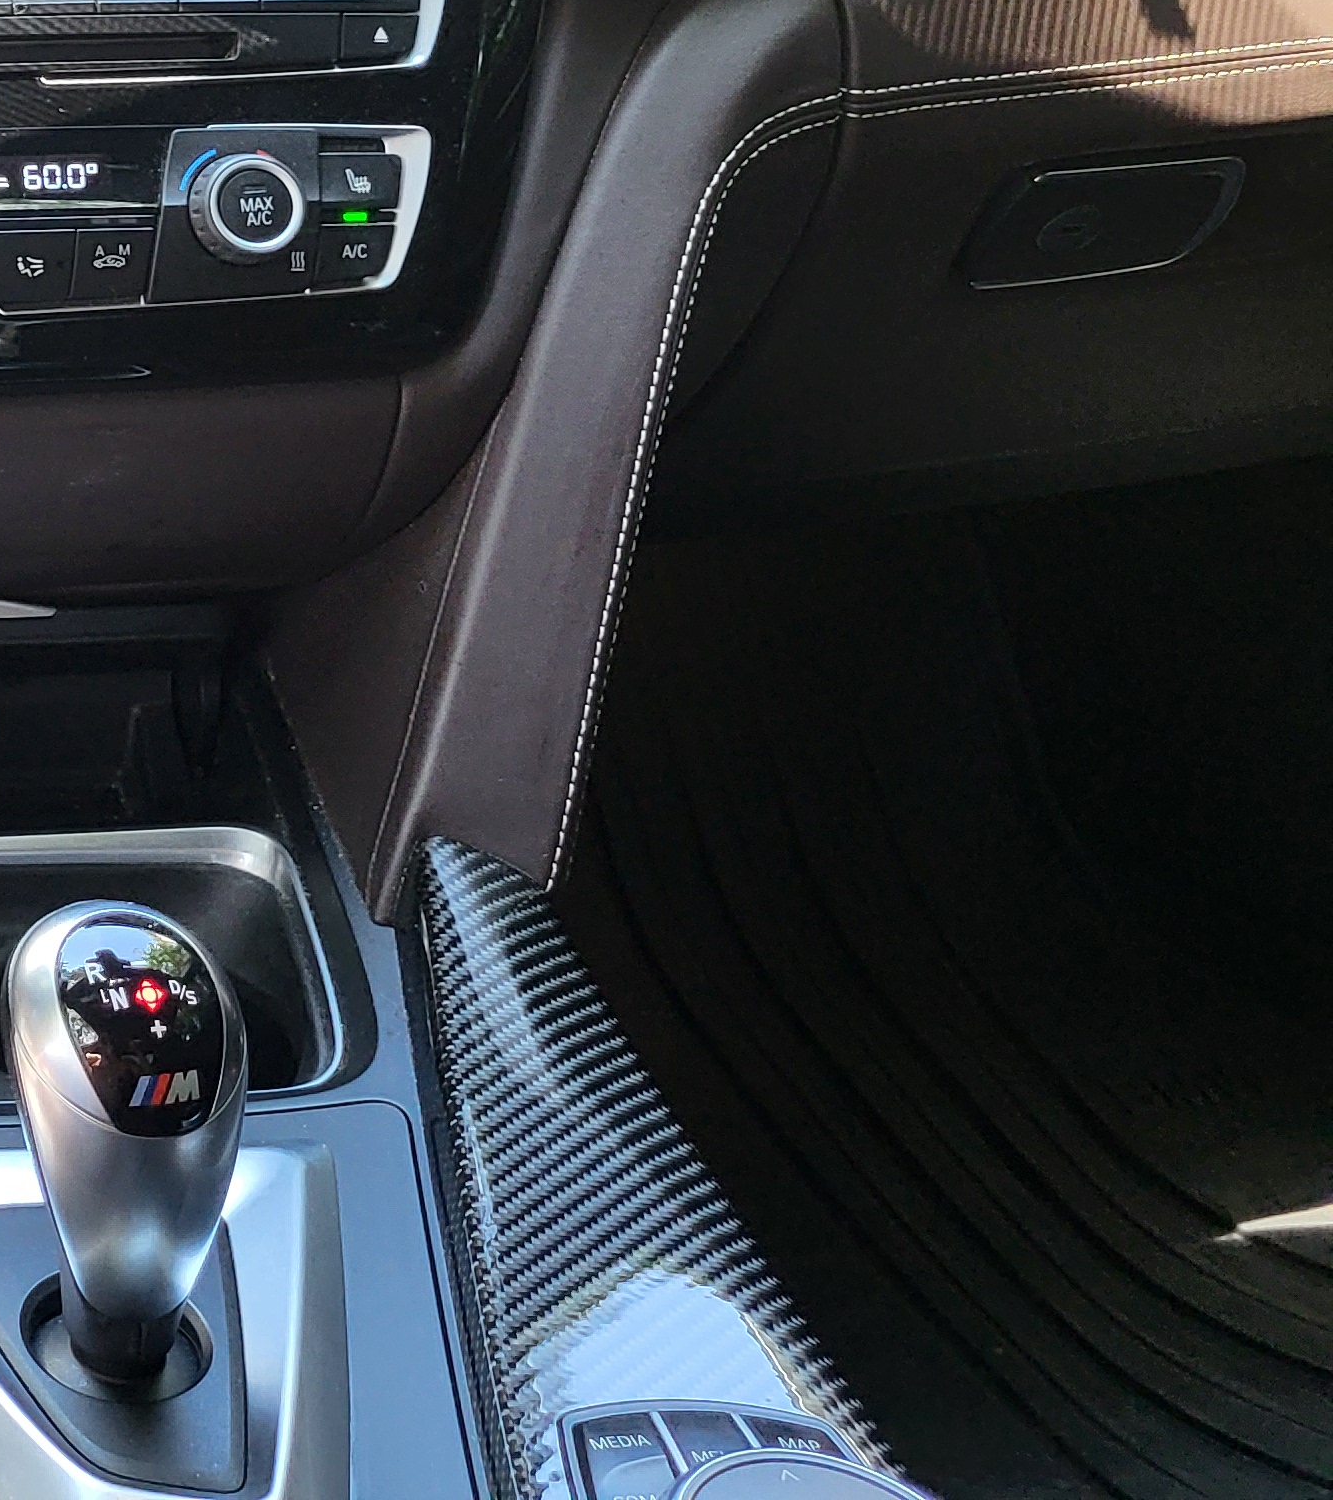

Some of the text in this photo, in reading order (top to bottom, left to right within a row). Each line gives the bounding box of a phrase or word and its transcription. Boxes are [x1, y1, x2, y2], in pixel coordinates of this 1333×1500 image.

[240, 196, 274, 214] MAX
[246, 210, 273, 227] A/C
[94, 243, 131, 257] A M
[342, 243, 368, 259] A/C
[84, 961, 106, 985] R
[108, 986, 129, 1011] N
[168, 979, 199, 1006] D/S
[588, 1434, 652, 1451] MEDIA
[777, 1436, 821, 1451] MAP
